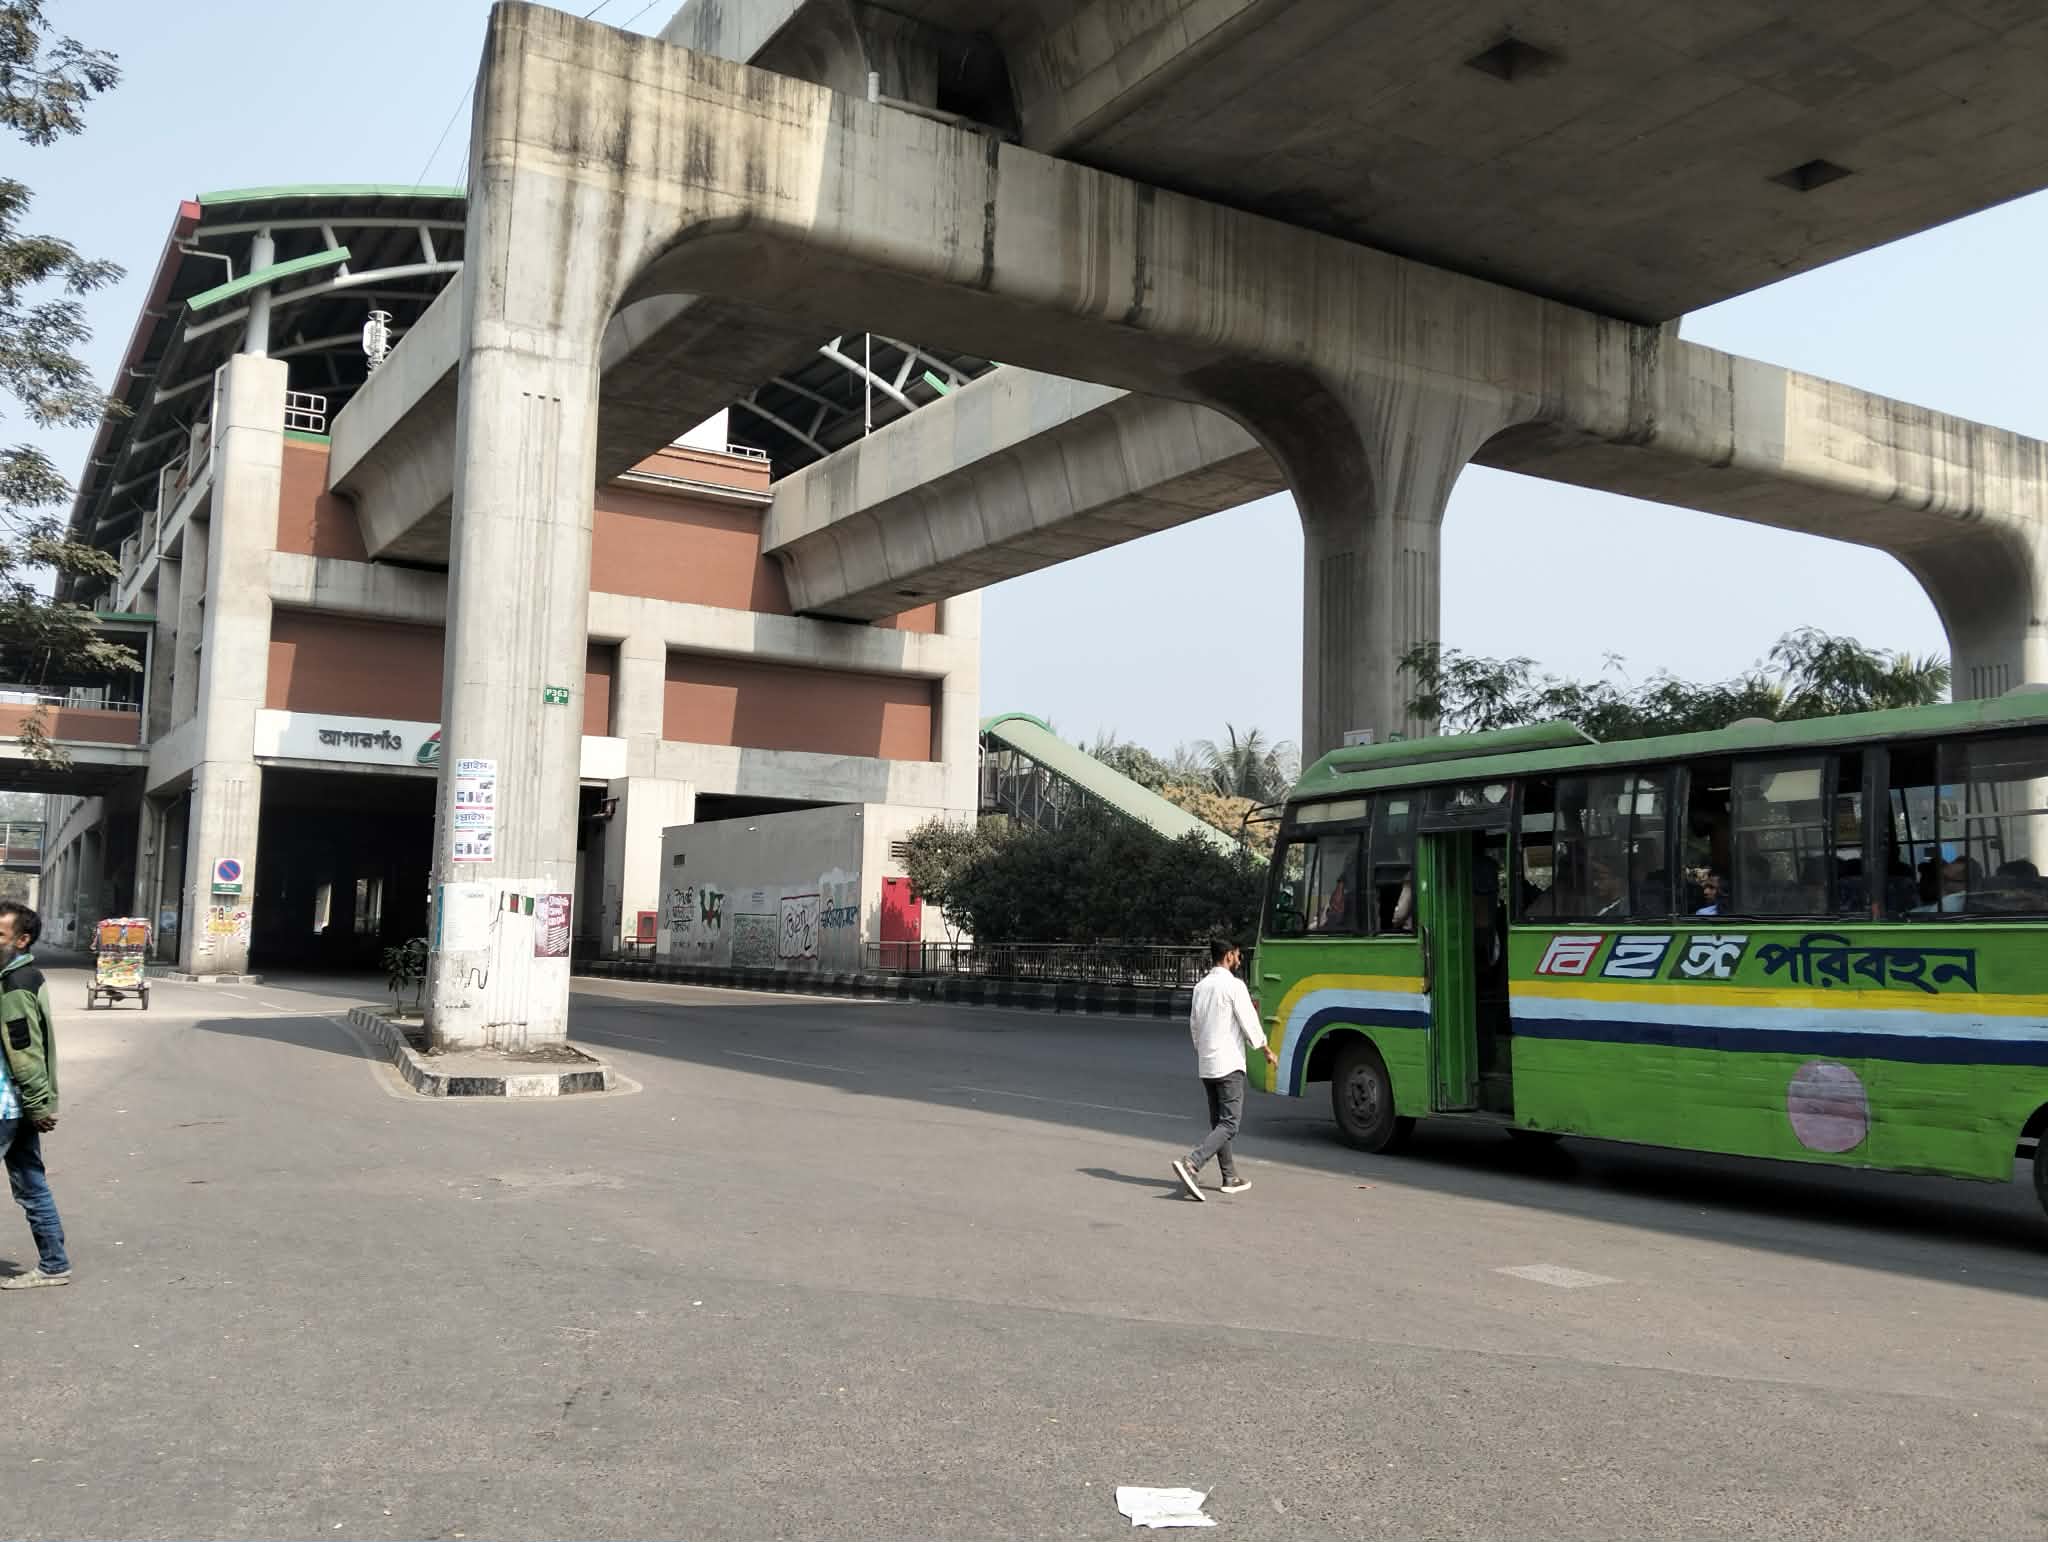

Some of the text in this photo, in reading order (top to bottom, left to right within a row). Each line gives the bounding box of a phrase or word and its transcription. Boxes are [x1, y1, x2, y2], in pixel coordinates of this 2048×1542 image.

[318, 729, 402, 751] আগারগাঁও
[1537, 932, 1978, 994] বিহঙ্গ পরিবহন
